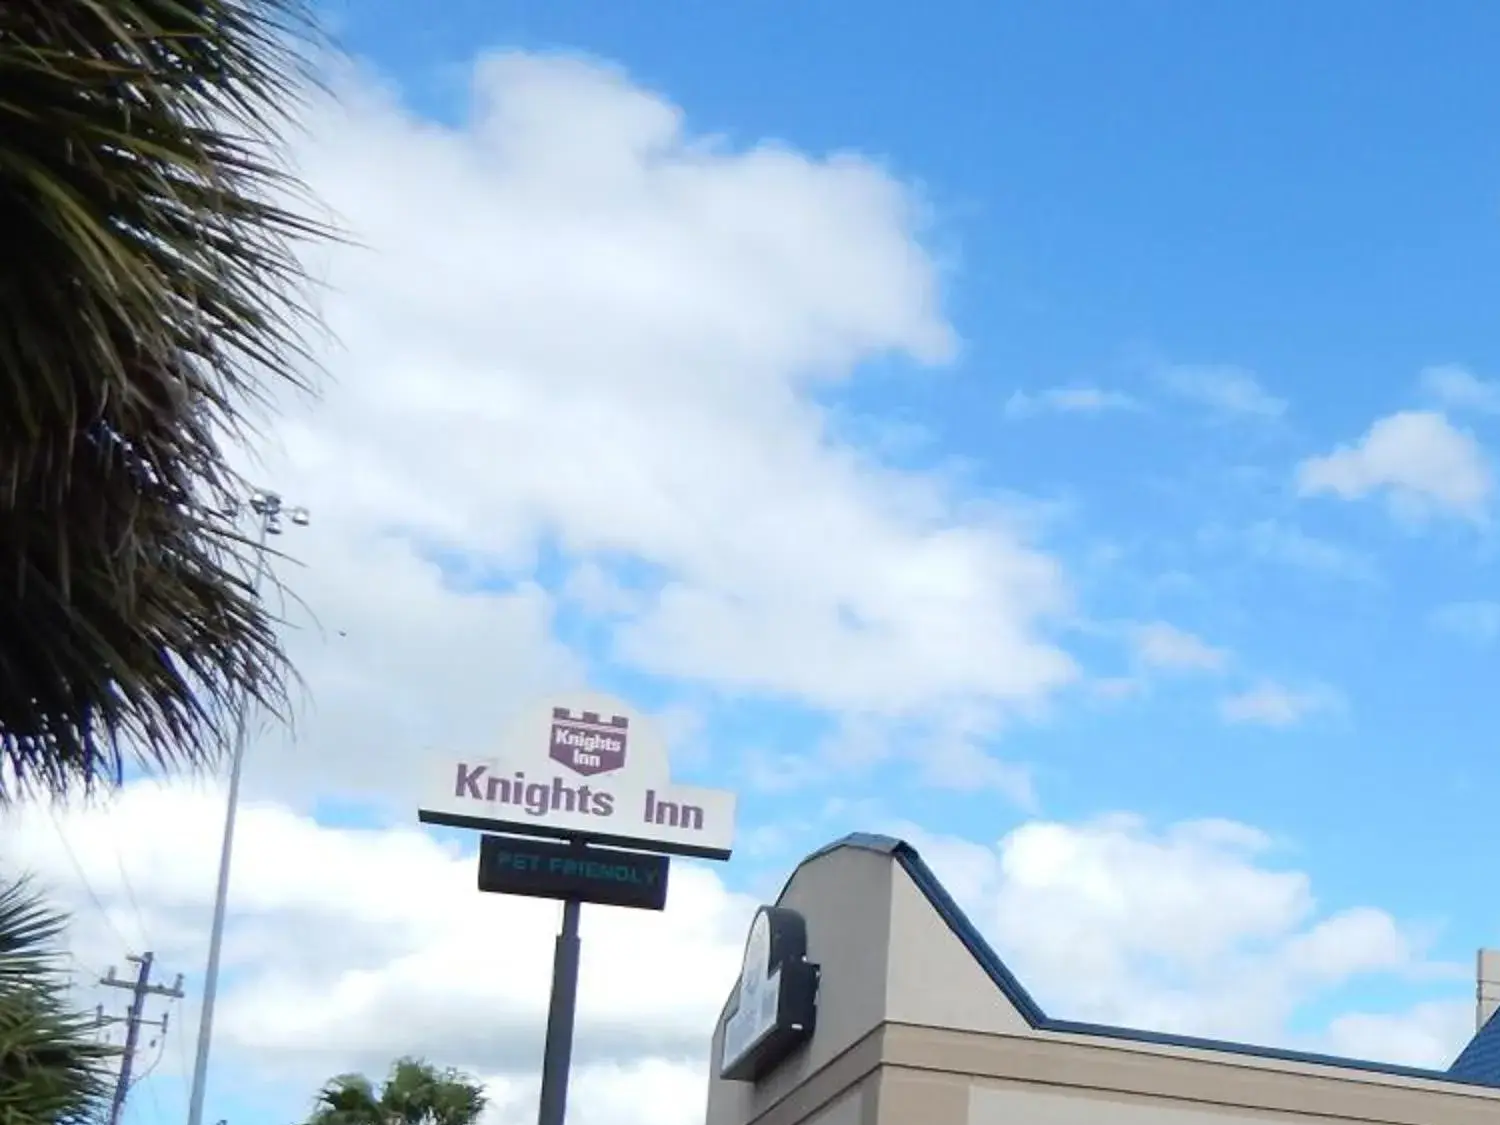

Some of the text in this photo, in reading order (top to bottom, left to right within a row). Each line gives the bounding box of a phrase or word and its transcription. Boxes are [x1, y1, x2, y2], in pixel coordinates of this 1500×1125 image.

[555, 728, 621, 753] Knights
[573, 750, 601, 767] Inn
[455, 763, 705, 830] Knights Inn
[498, 852, 658, 885] PET FRIENDLY
